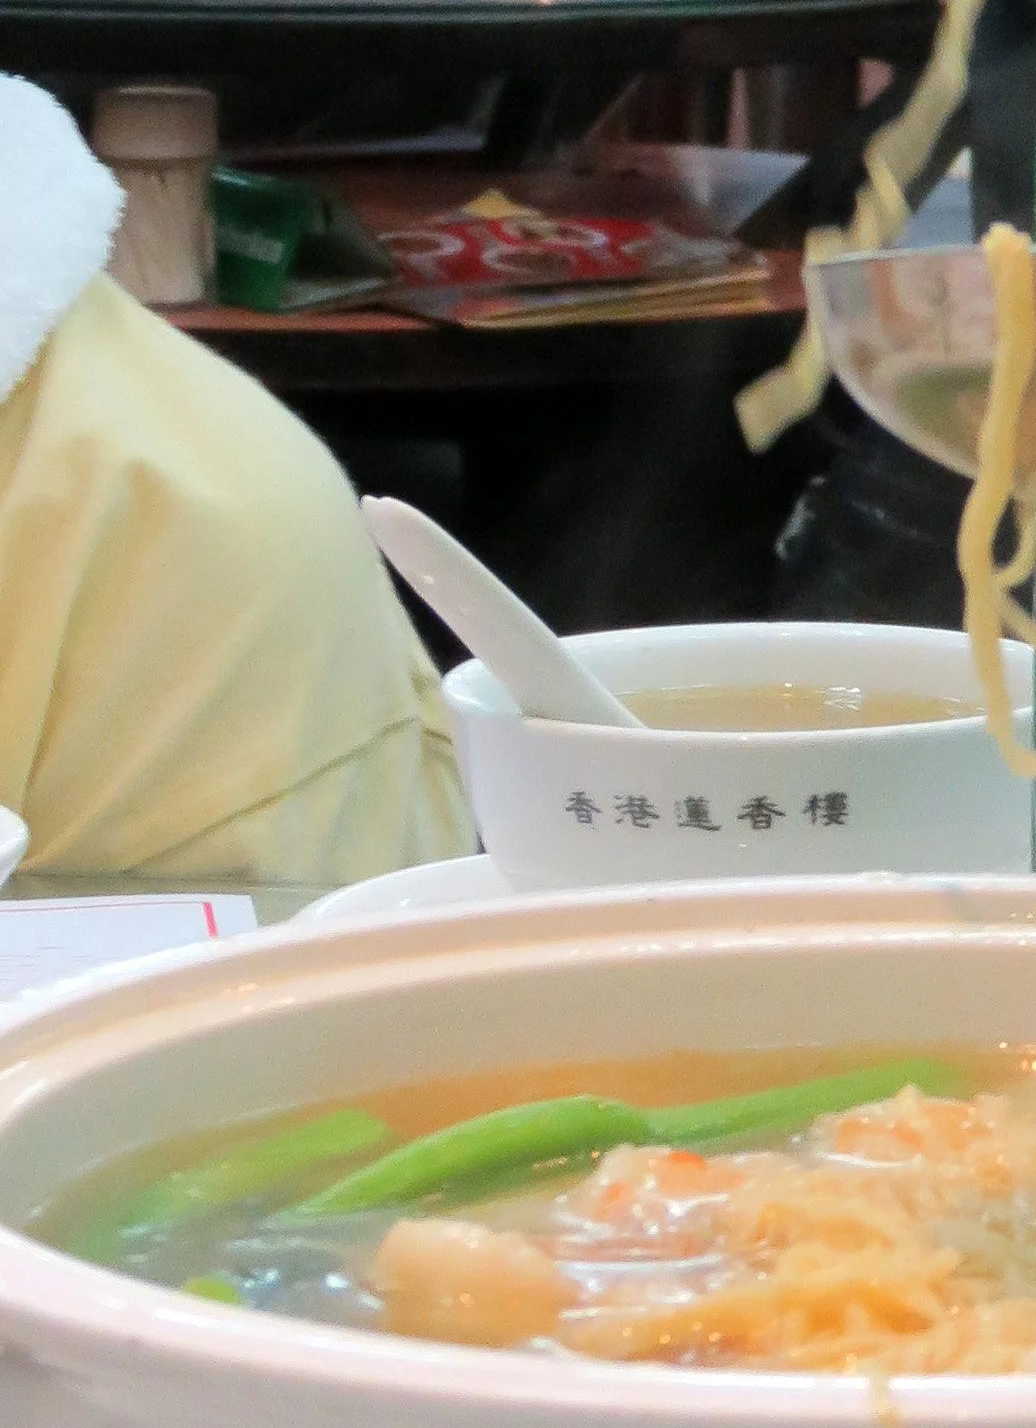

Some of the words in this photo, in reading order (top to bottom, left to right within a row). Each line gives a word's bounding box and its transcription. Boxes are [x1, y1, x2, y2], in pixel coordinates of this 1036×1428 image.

[565, 790, 850, 832] 香港蓮香樓
